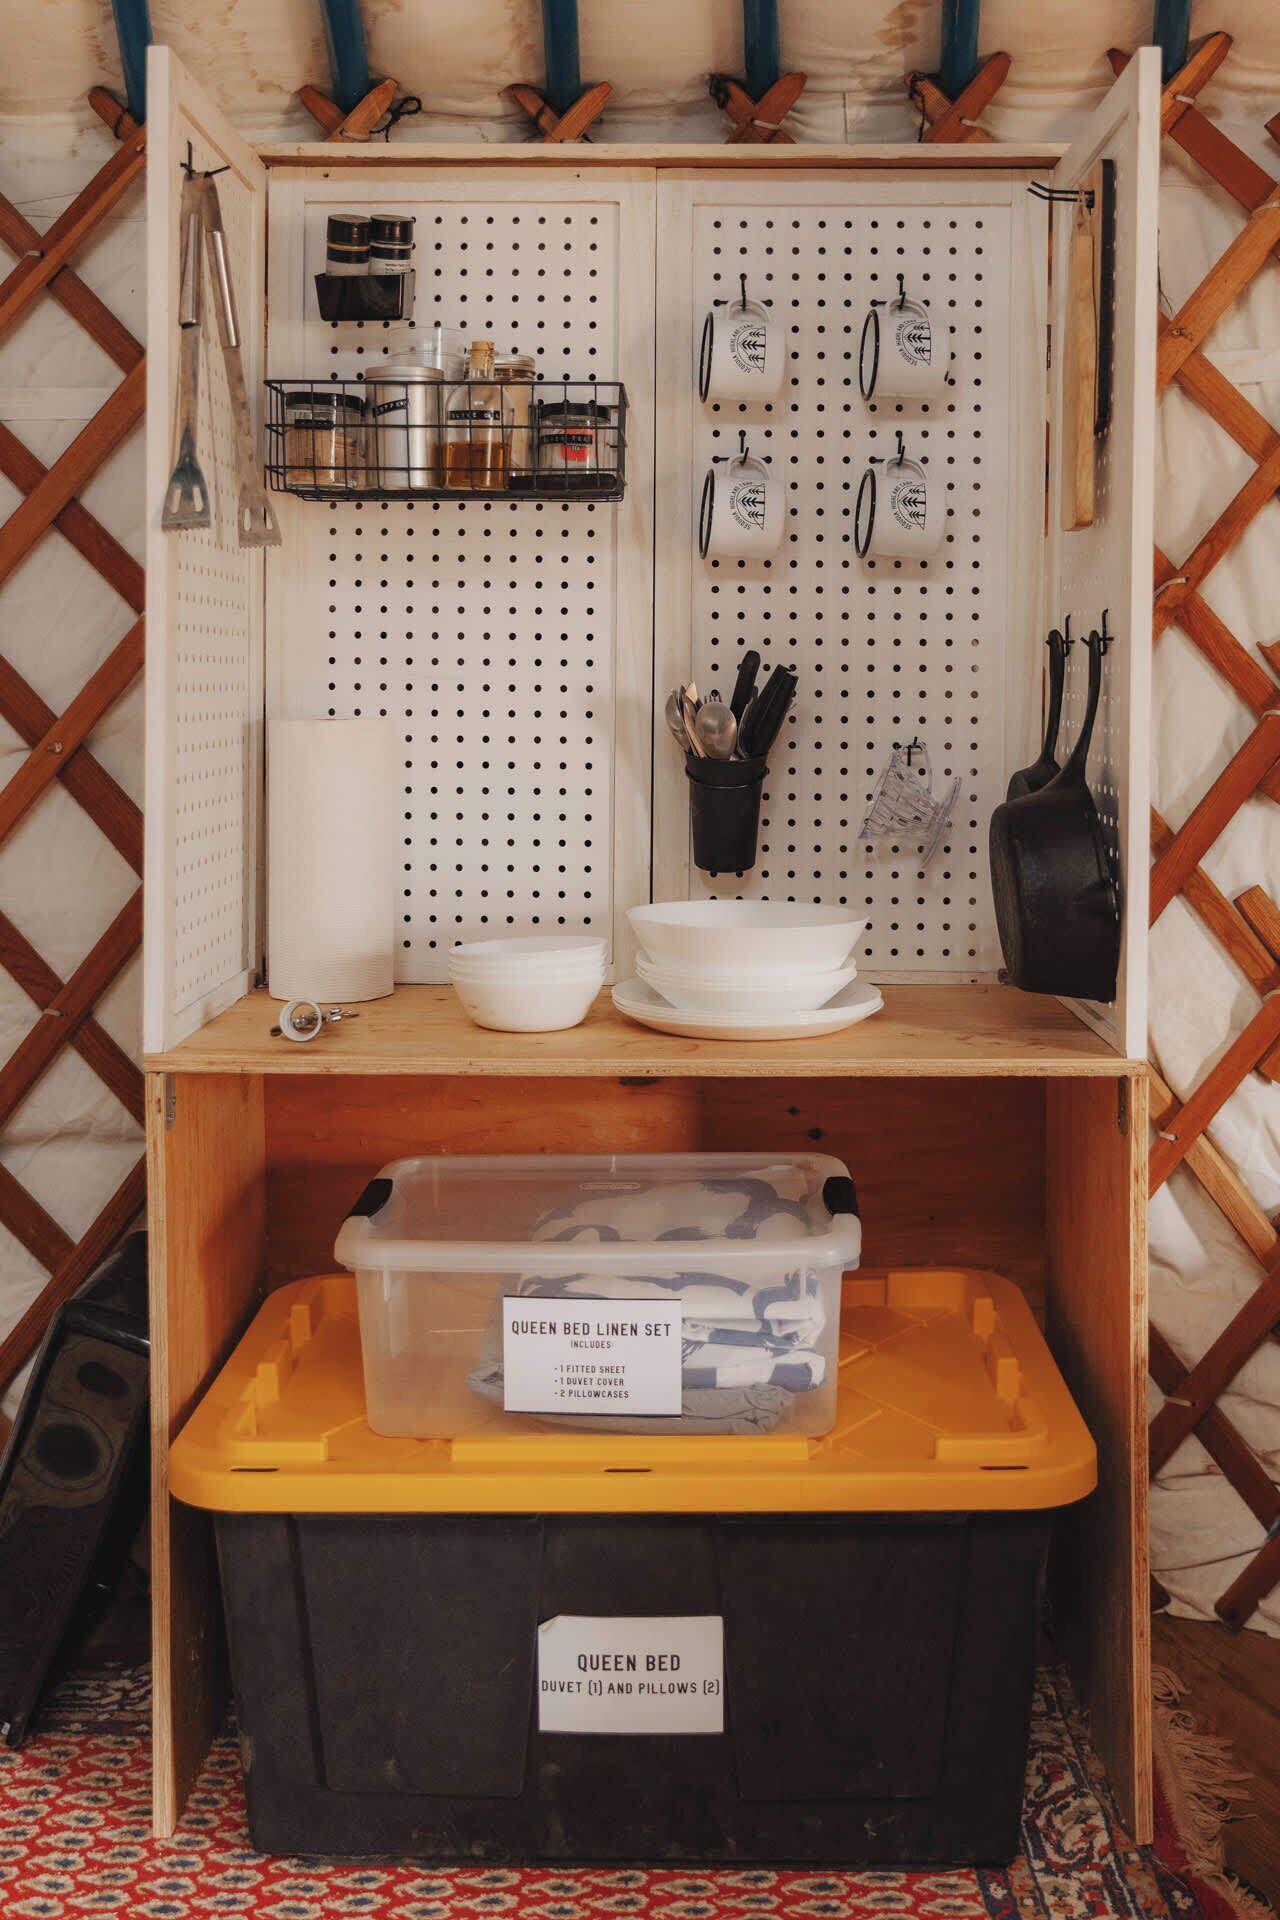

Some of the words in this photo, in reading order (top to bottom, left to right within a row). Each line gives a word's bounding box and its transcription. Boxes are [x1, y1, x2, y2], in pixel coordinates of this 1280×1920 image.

[511, 1320, 557, 1335] QUEEN
[563, 1322, 590, 1336] BED
[597, 1323, 638, 1336] LINEN
[645, 1323, 672, 1337] SET
[566, 1364, 596, 1373] FITTED
[599, 1365, 626, 1374] SHEET
[566, 1377, 594, 1386] DUVET
[597, 1378, 625, 1386] COVER
[568, 1389, 629, 1399] PILLOWCASES
[577, 1654, 637, 1672] QUEEN
[646, 1655, 681, 1671] BED
[541, 1680, 582, 1693] DUVET
[607, 1682, 633, 1694] AND
[638, 1682, 697, 1695] PILLOWS
